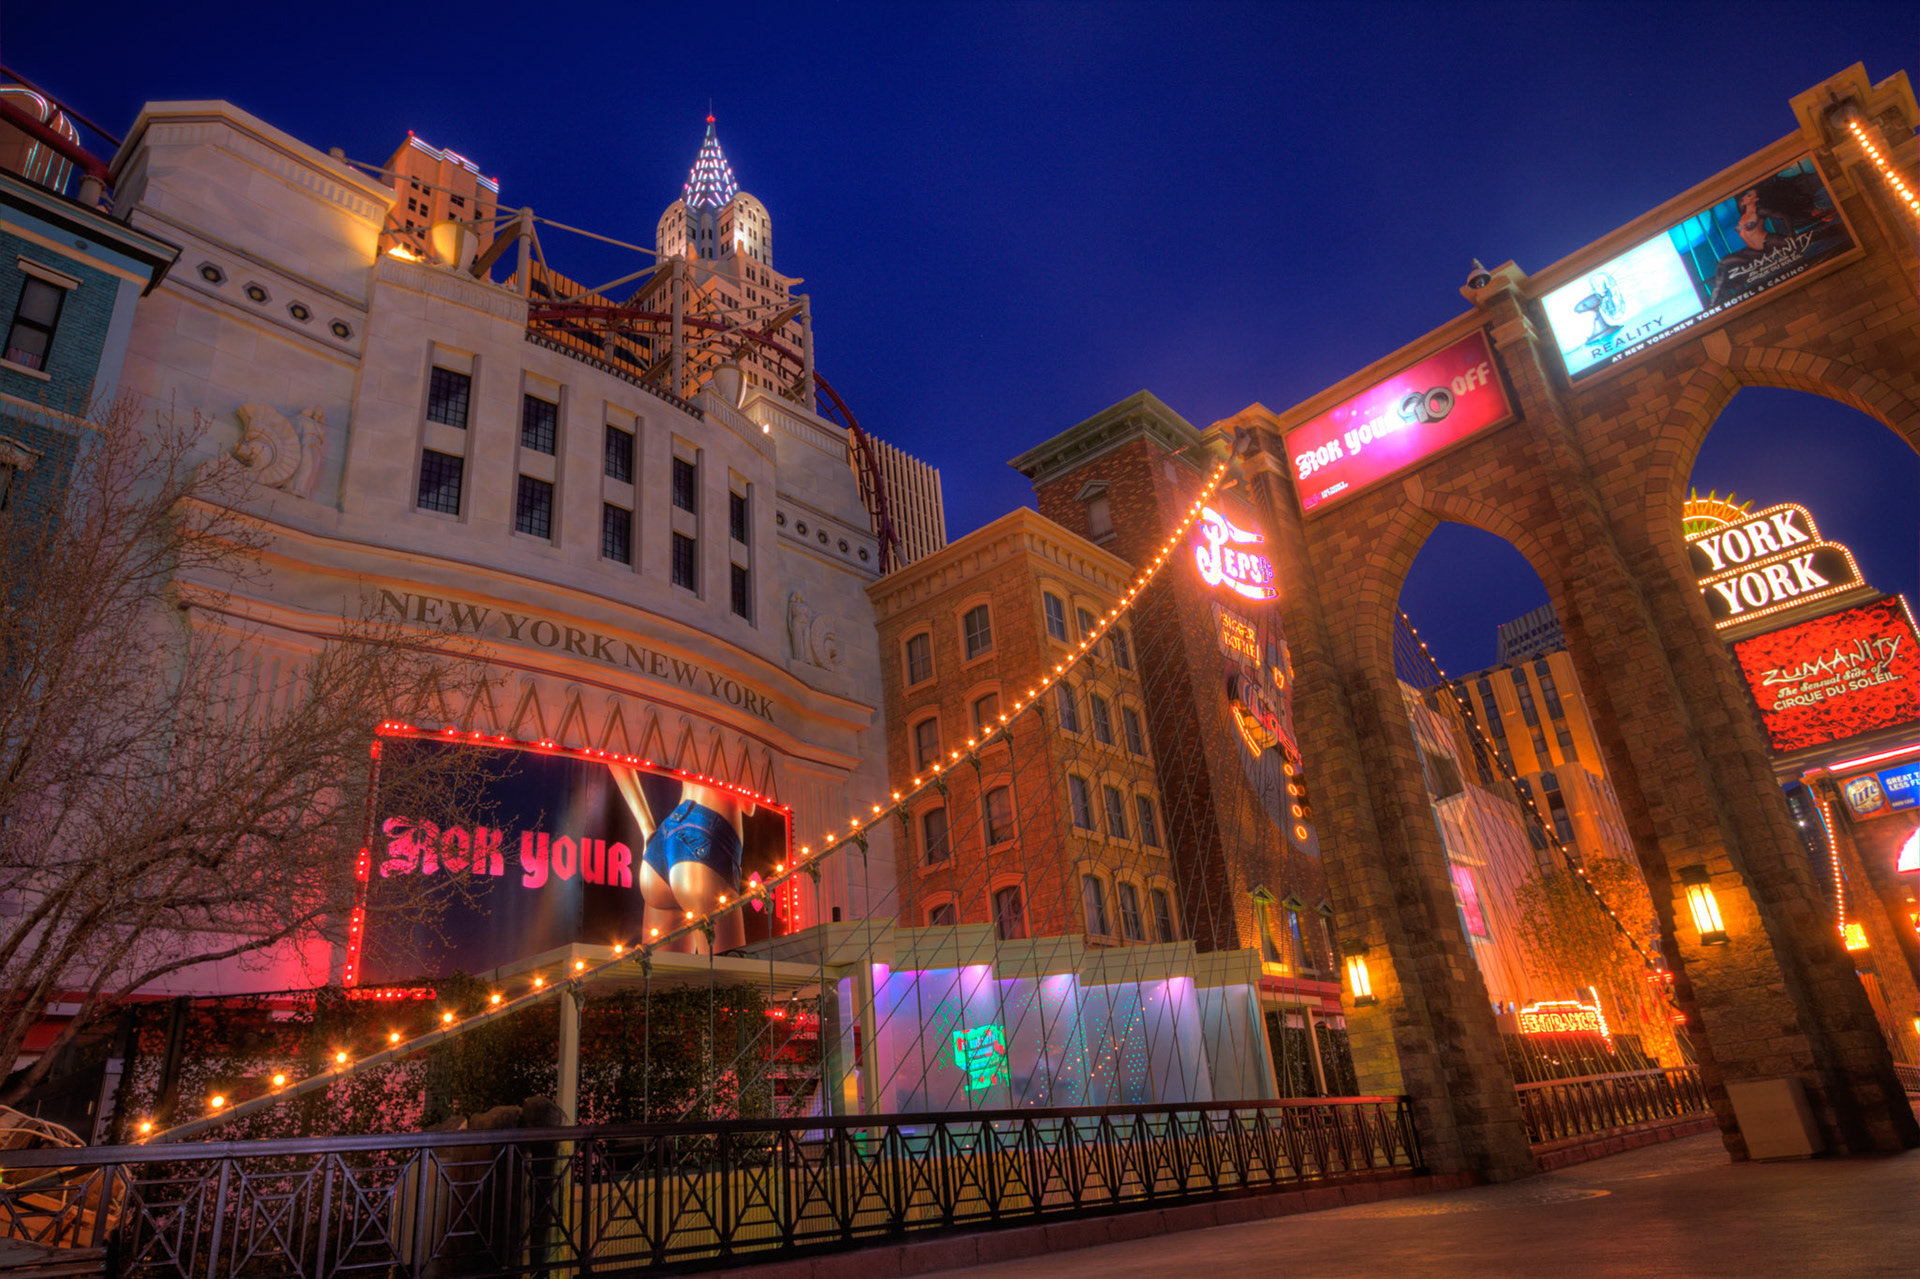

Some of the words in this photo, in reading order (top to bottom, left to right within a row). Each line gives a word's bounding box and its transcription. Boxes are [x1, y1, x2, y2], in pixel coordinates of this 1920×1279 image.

[1728, 230, 1813, 279] ZUMANITY
[1591, 316, 1664, 359] REALITY
[1611, 354, 1623, 363] AT
[1625, 343, 1645, 357] NEW
[1697, 305, 1722, 321] YORK
[1724, 290, 1755, 308] HOTEL
[1767, 266, 1804, 287] CASINO
[1696, 510, 1809, 571] YORK
[1713, 553, 1829, 615] YORK
[380, 589, 490, 632] NEW
[501, 612, 617, 665] YORK
[623, 643, 700, 687] NEW
[705, 668, 775, 722] YORK
[1761, 635, 1901, 686] ZUMANITY
[1773, 690, 1824, 711] CIRQUE
[1826, 684, 1846, 697] DU
[1849, 672, 1898, 691] SOLEIL
[1778, 687, 1798, 699] The
[1800, 674, 1840, 692] Sensual
[1843, 668, 1867, 680] Side
[1870, 661, 1883, 676] of
[1886, 774, 1912, 785] GREAT
[1889, 781, 1910, 791] LESS
[1524, 1012, 1598, 1033] ENTRANCE
